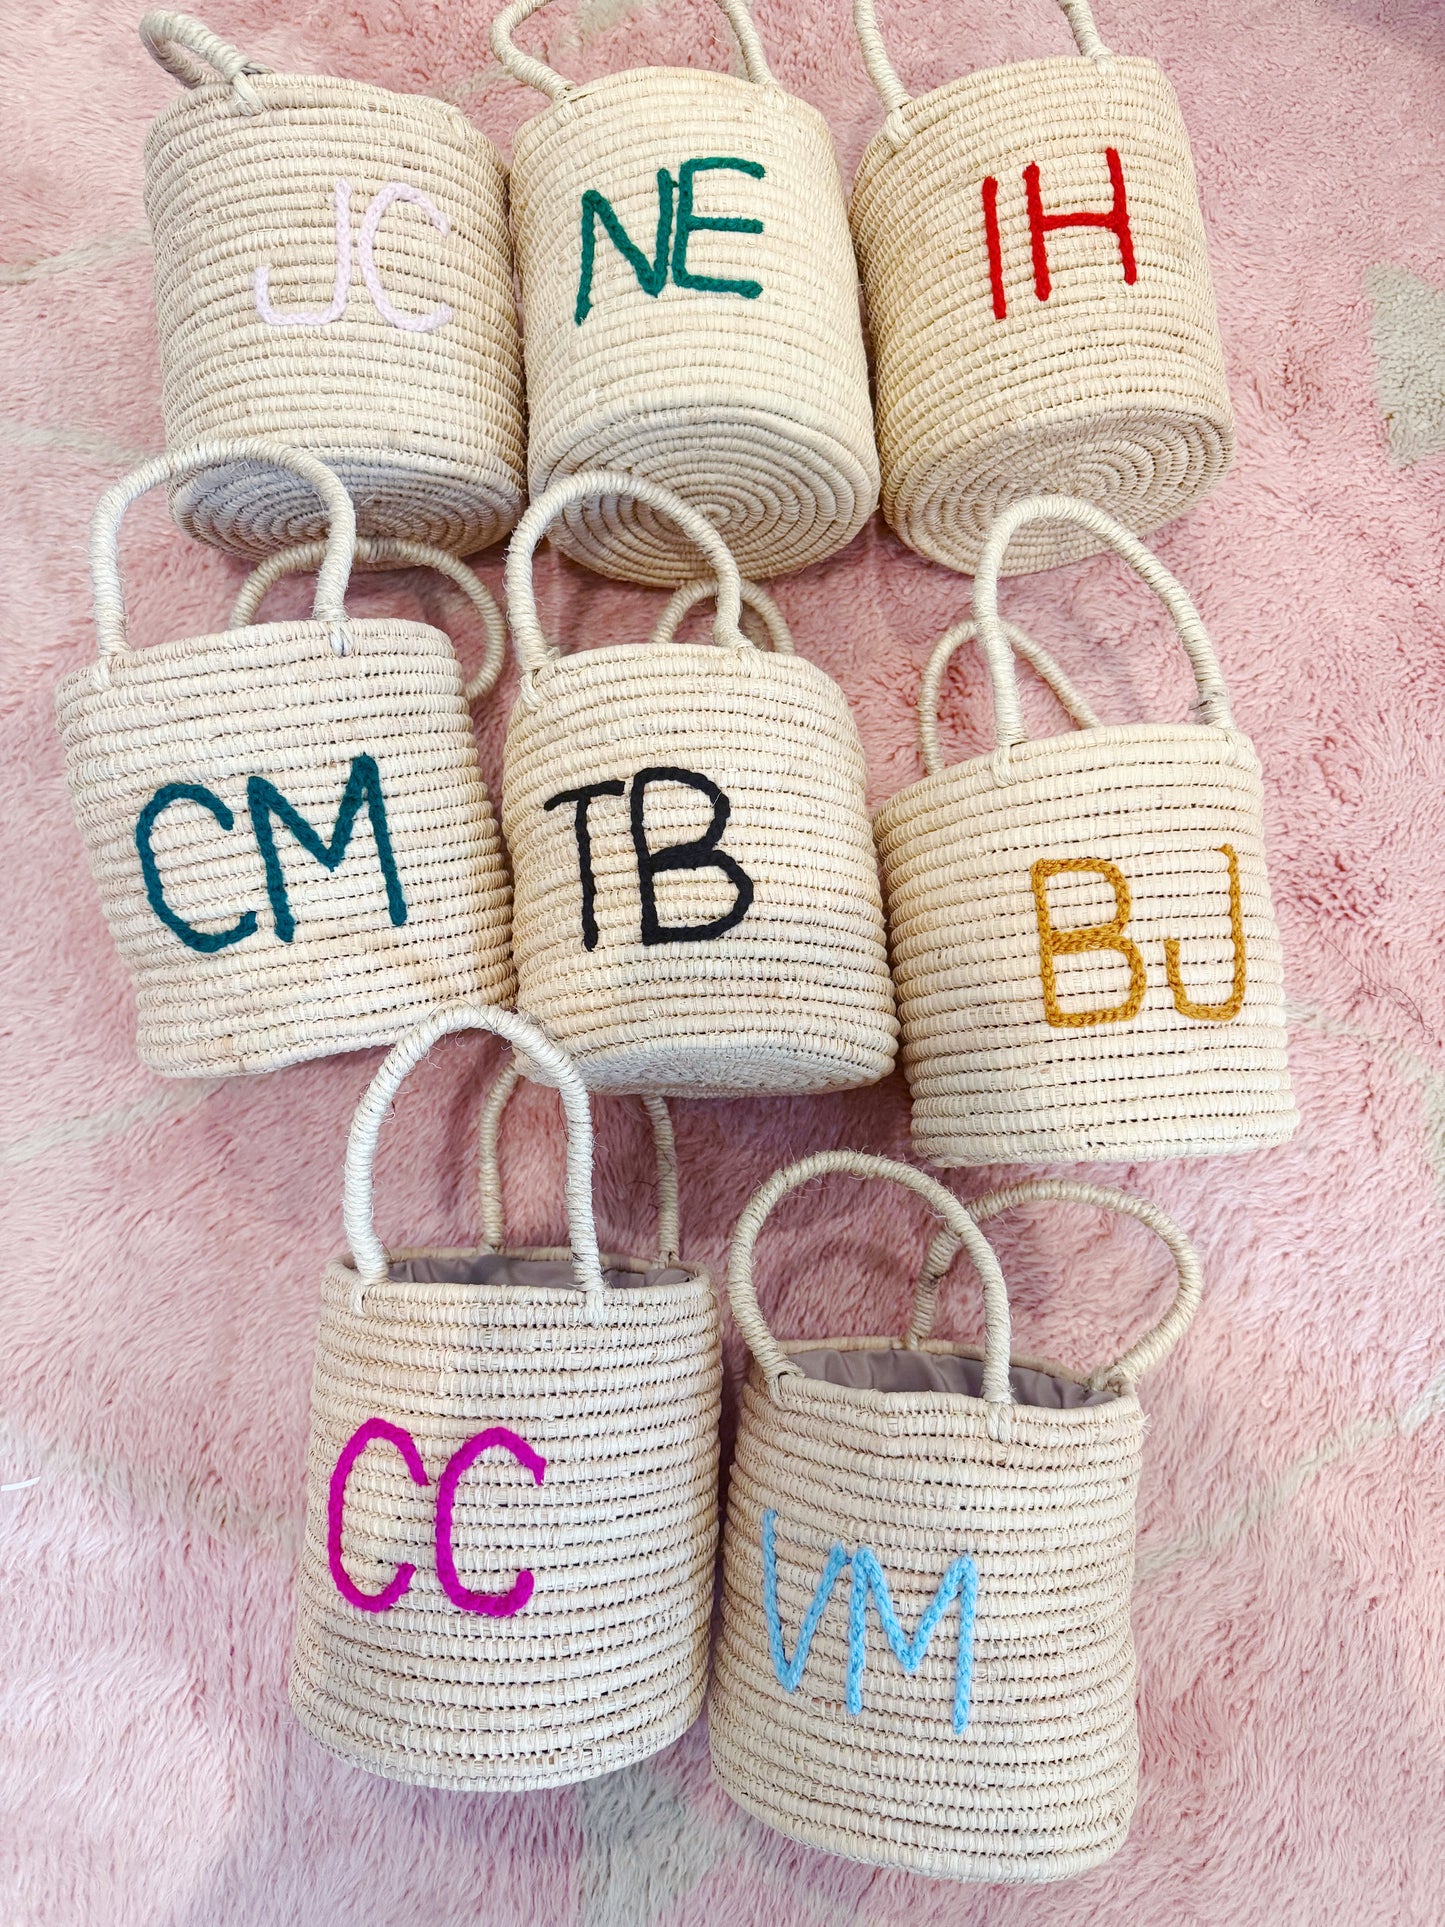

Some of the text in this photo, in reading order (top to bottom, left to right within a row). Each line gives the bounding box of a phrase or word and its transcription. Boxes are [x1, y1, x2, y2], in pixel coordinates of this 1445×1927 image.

[253, 179, 453, 334] JC
[575, 156, 764, 326] NE
[982, 147, 1136, 318] IH
[136, 753, 405, 953] CM
[544, 767, 753, 950] TB
[1033, 844, 1246, 1026] BJ
[328, 1418, 544, 1617] CC
[762, 1510, 979, 1734] VM
